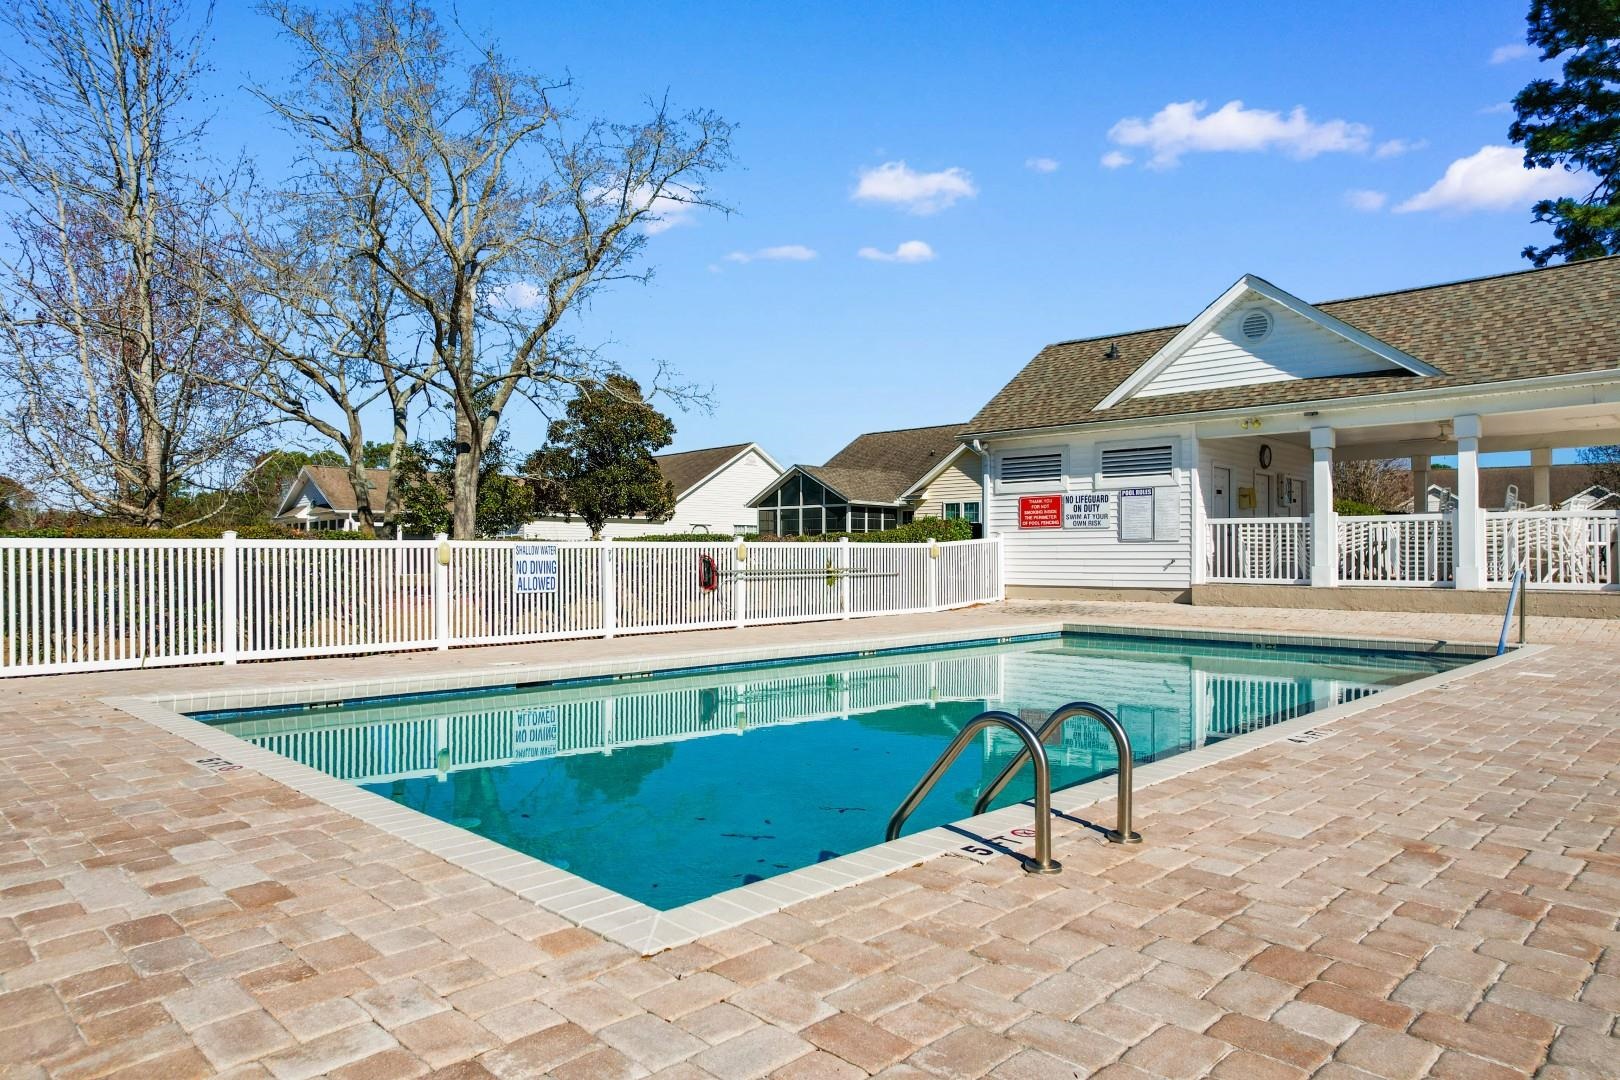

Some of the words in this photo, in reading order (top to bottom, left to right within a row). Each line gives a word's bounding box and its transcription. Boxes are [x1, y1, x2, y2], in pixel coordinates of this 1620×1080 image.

[1066, 495, 1073, 504] NO
[1075, 494, 1109, 503] LIFEGUARD
[1073, 504, 1081, 512] ON
[1084, 504, 1100, 512] DUTY
[516, 545, 539, 555] SHALLOW
[540, 545, 556, 555] WATER
[516, 560, 528, 574] NO
[530, 560, 557, 574] DIVING
[517, 576, 556, 591] ALLOWED
[960, 845, 994, 856] 5
